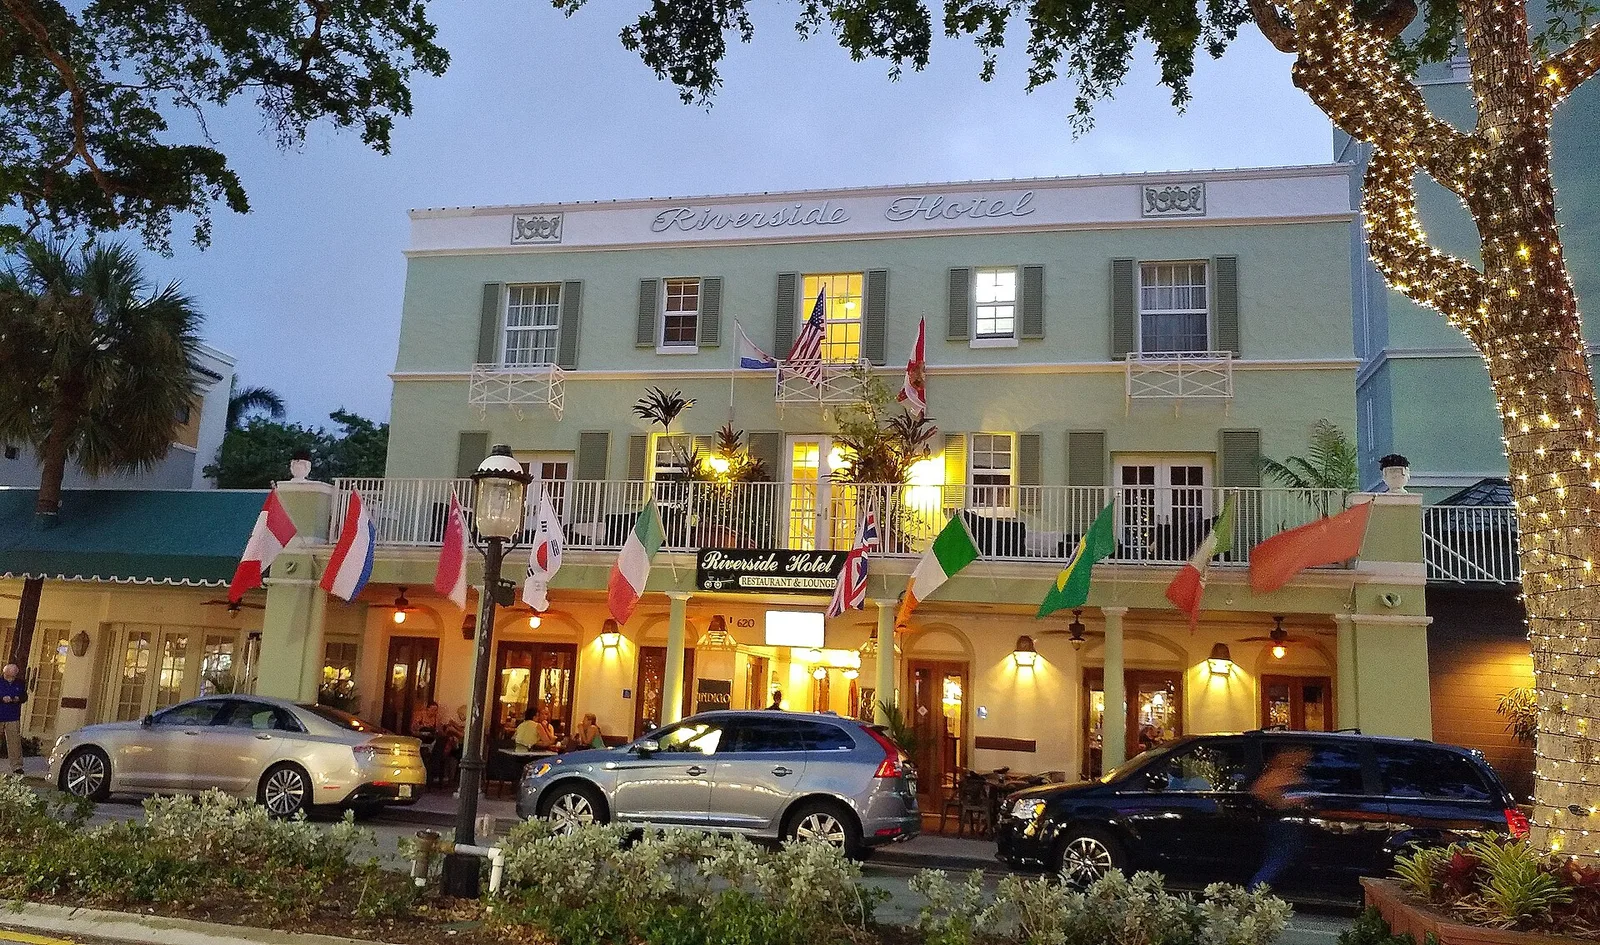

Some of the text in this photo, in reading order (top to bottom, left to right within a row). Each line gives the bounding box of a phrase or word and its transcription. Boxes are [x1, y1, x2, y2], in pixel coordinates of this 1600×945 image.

[651, 190, 1035, 233] Riverside Hotel
[701, 550, 837, 573] Riverside Hotel
[741, 577, 837, 589] RESTAURANT & LOUNGE
[737, 618, 756, 628] 620
[696, 692, 731, 703] INDIGO
